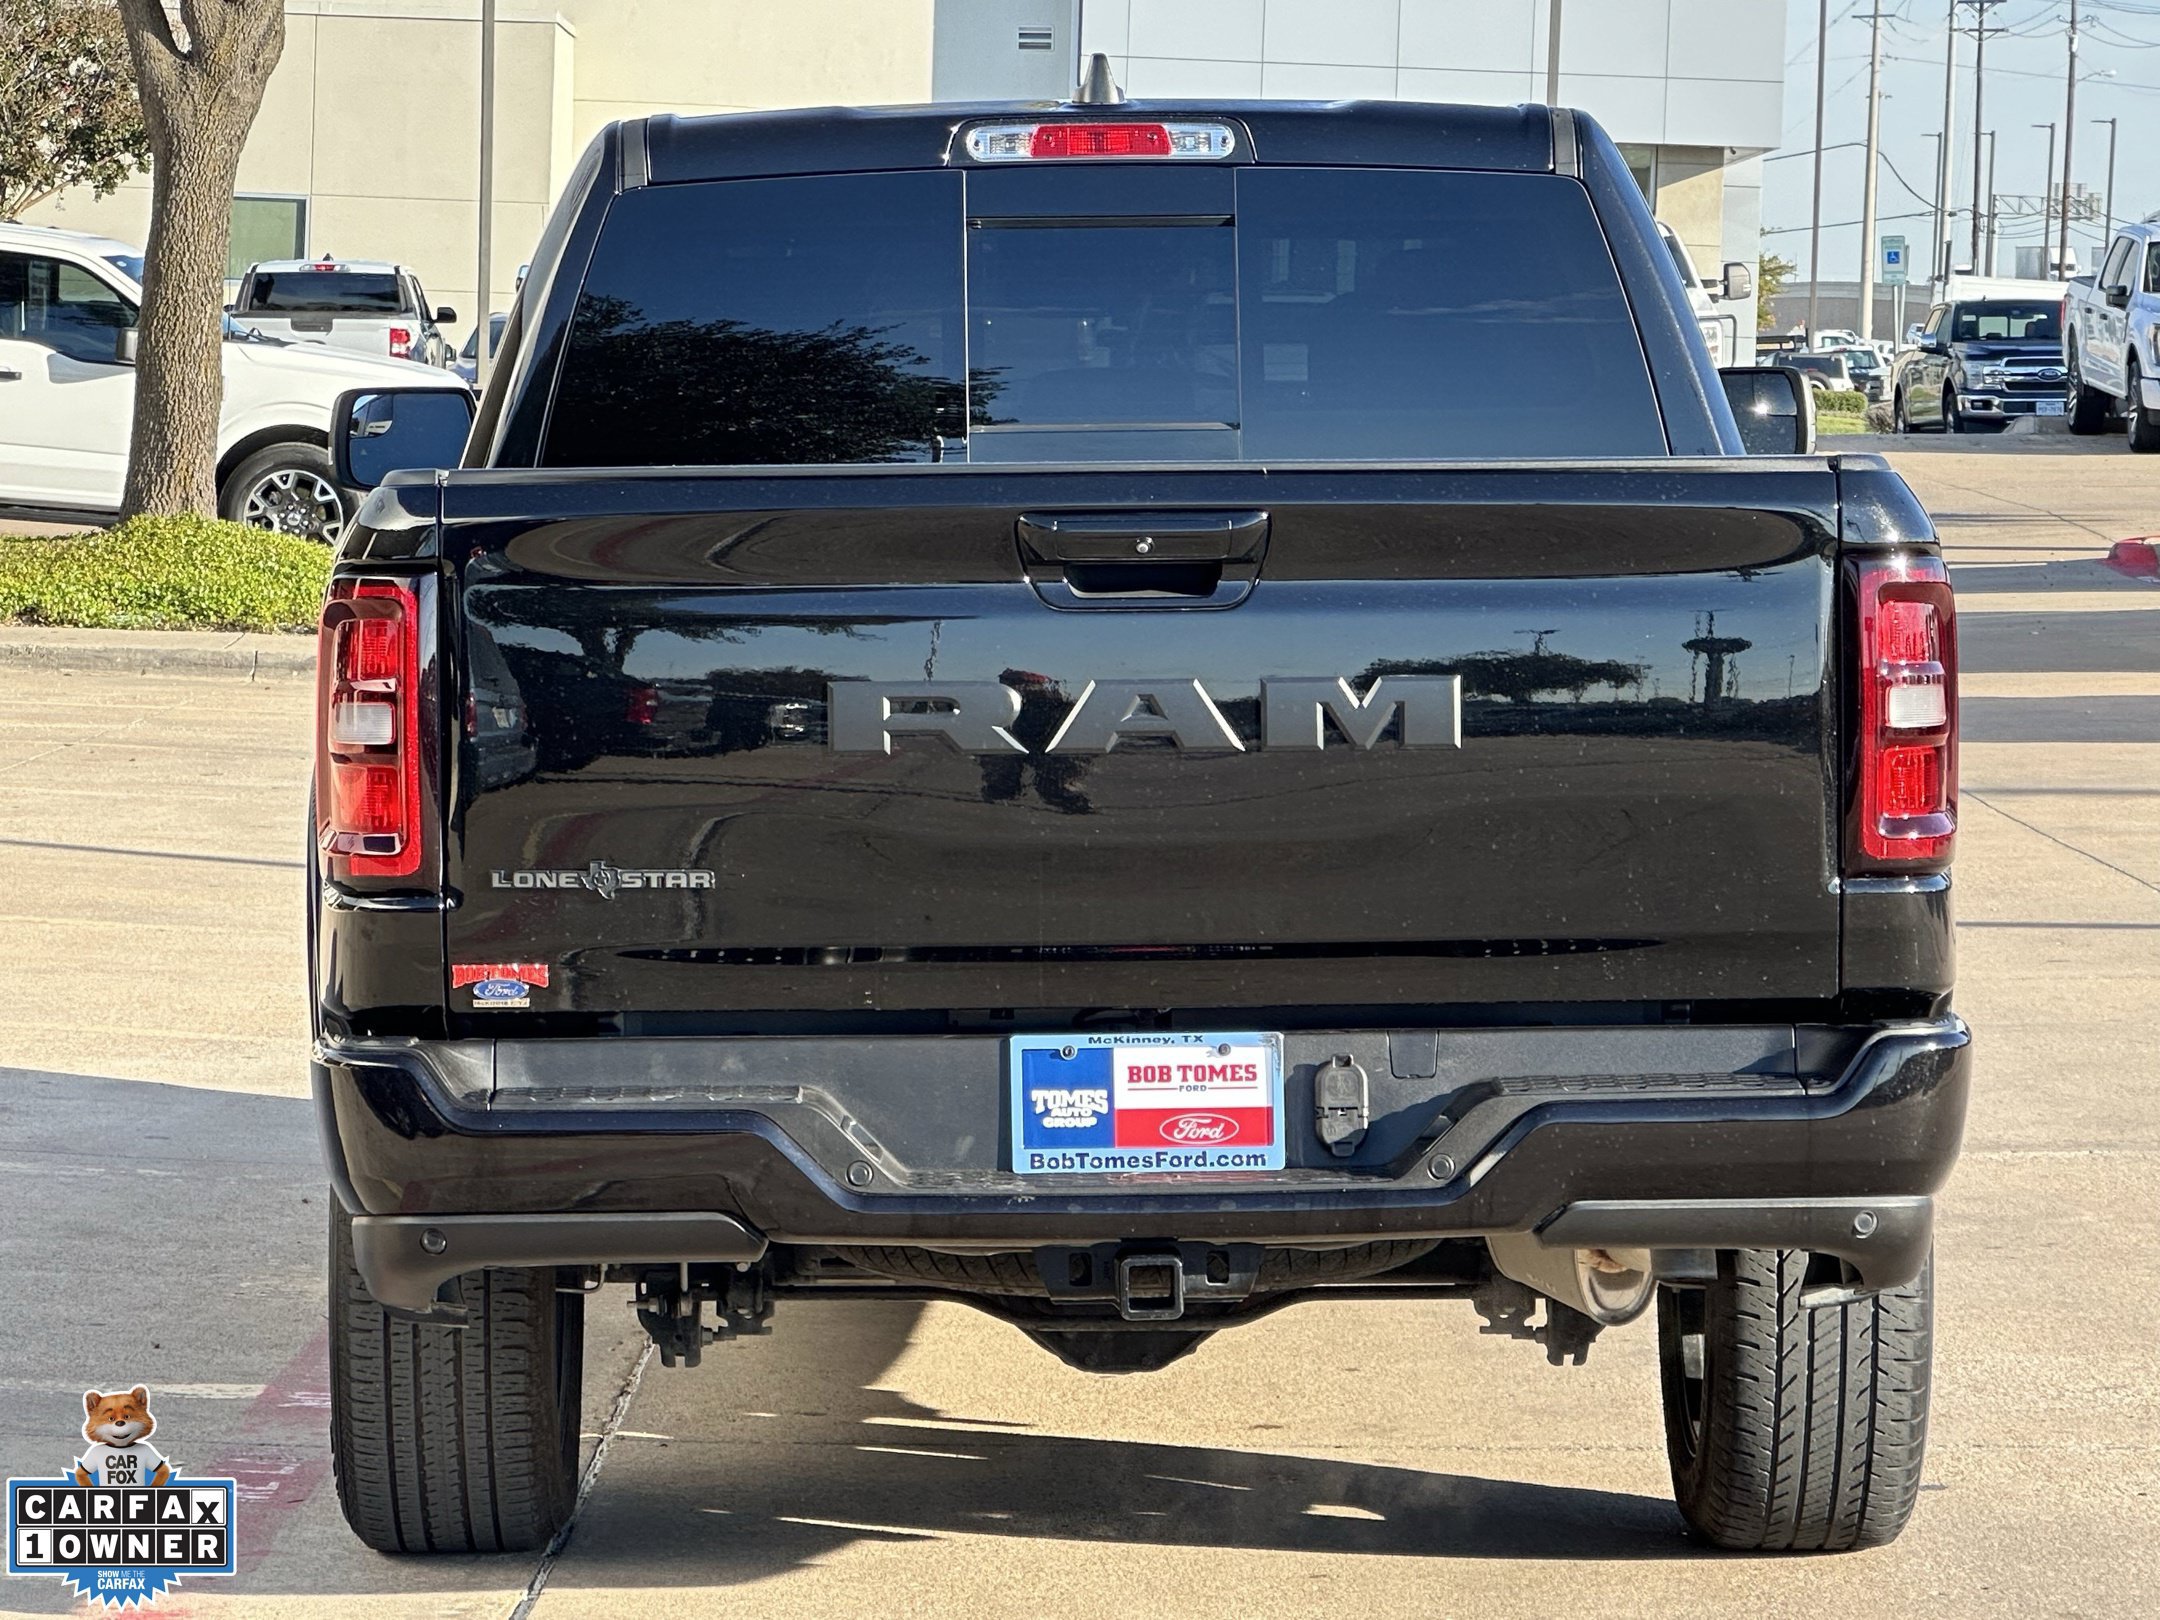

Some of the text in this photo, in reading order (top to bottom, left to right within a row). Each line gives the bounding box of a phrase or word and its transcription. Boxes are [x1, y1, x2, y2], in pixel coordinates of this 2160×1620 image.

[826, 674, 1462, 755] RAM
[491, 869, 716, 889] LONE STAR
[484, 983, 519, 997] Ford
[1088, 1035, 1204, 1046] McKinney, TX
[1127, 1064, 1258, 1084] BOB TOMES
[1031, 1089, 1109, 1115] TOMES
[1051, 1107, 1093, 1117] AUTO
[1042, 1116, 1098, 1129] GROUP
[1173, 1117, 1225, 1140] Ford
[1030, 1152, 1267, 1170] BobTomesFord.com
